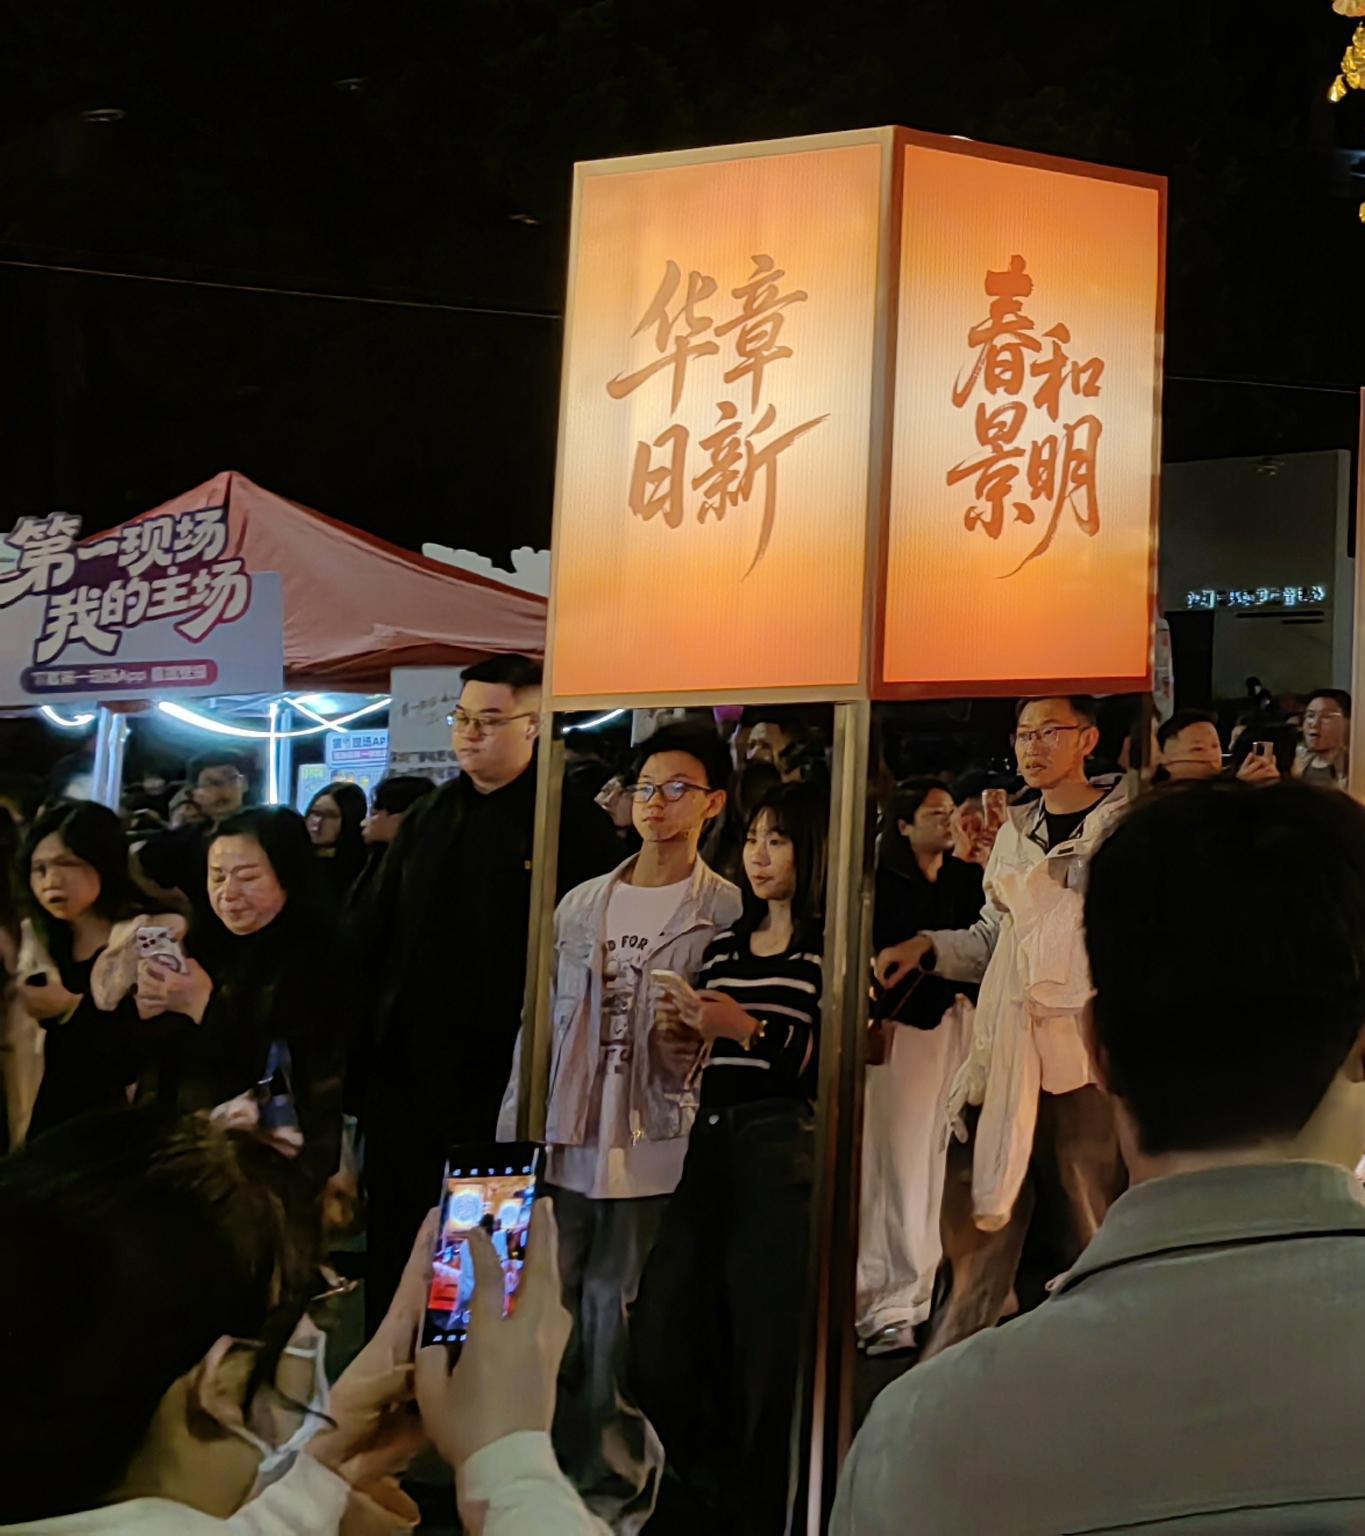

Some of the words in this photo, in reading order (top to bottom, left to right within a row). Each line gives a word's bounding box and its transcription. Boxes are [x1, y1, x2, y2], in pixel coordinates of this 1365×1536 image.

[605, 254, 809, 418] 华章
[951, 254, 1106, 421] 春和
[0, 513, 229, 606] 第一现场
[627, 401, 831, 582] 日新
[945, 402, 1104, 579] 景明
[34, 560, 249, 664] 我的主场
[621, 935, 648, 951] FOR
